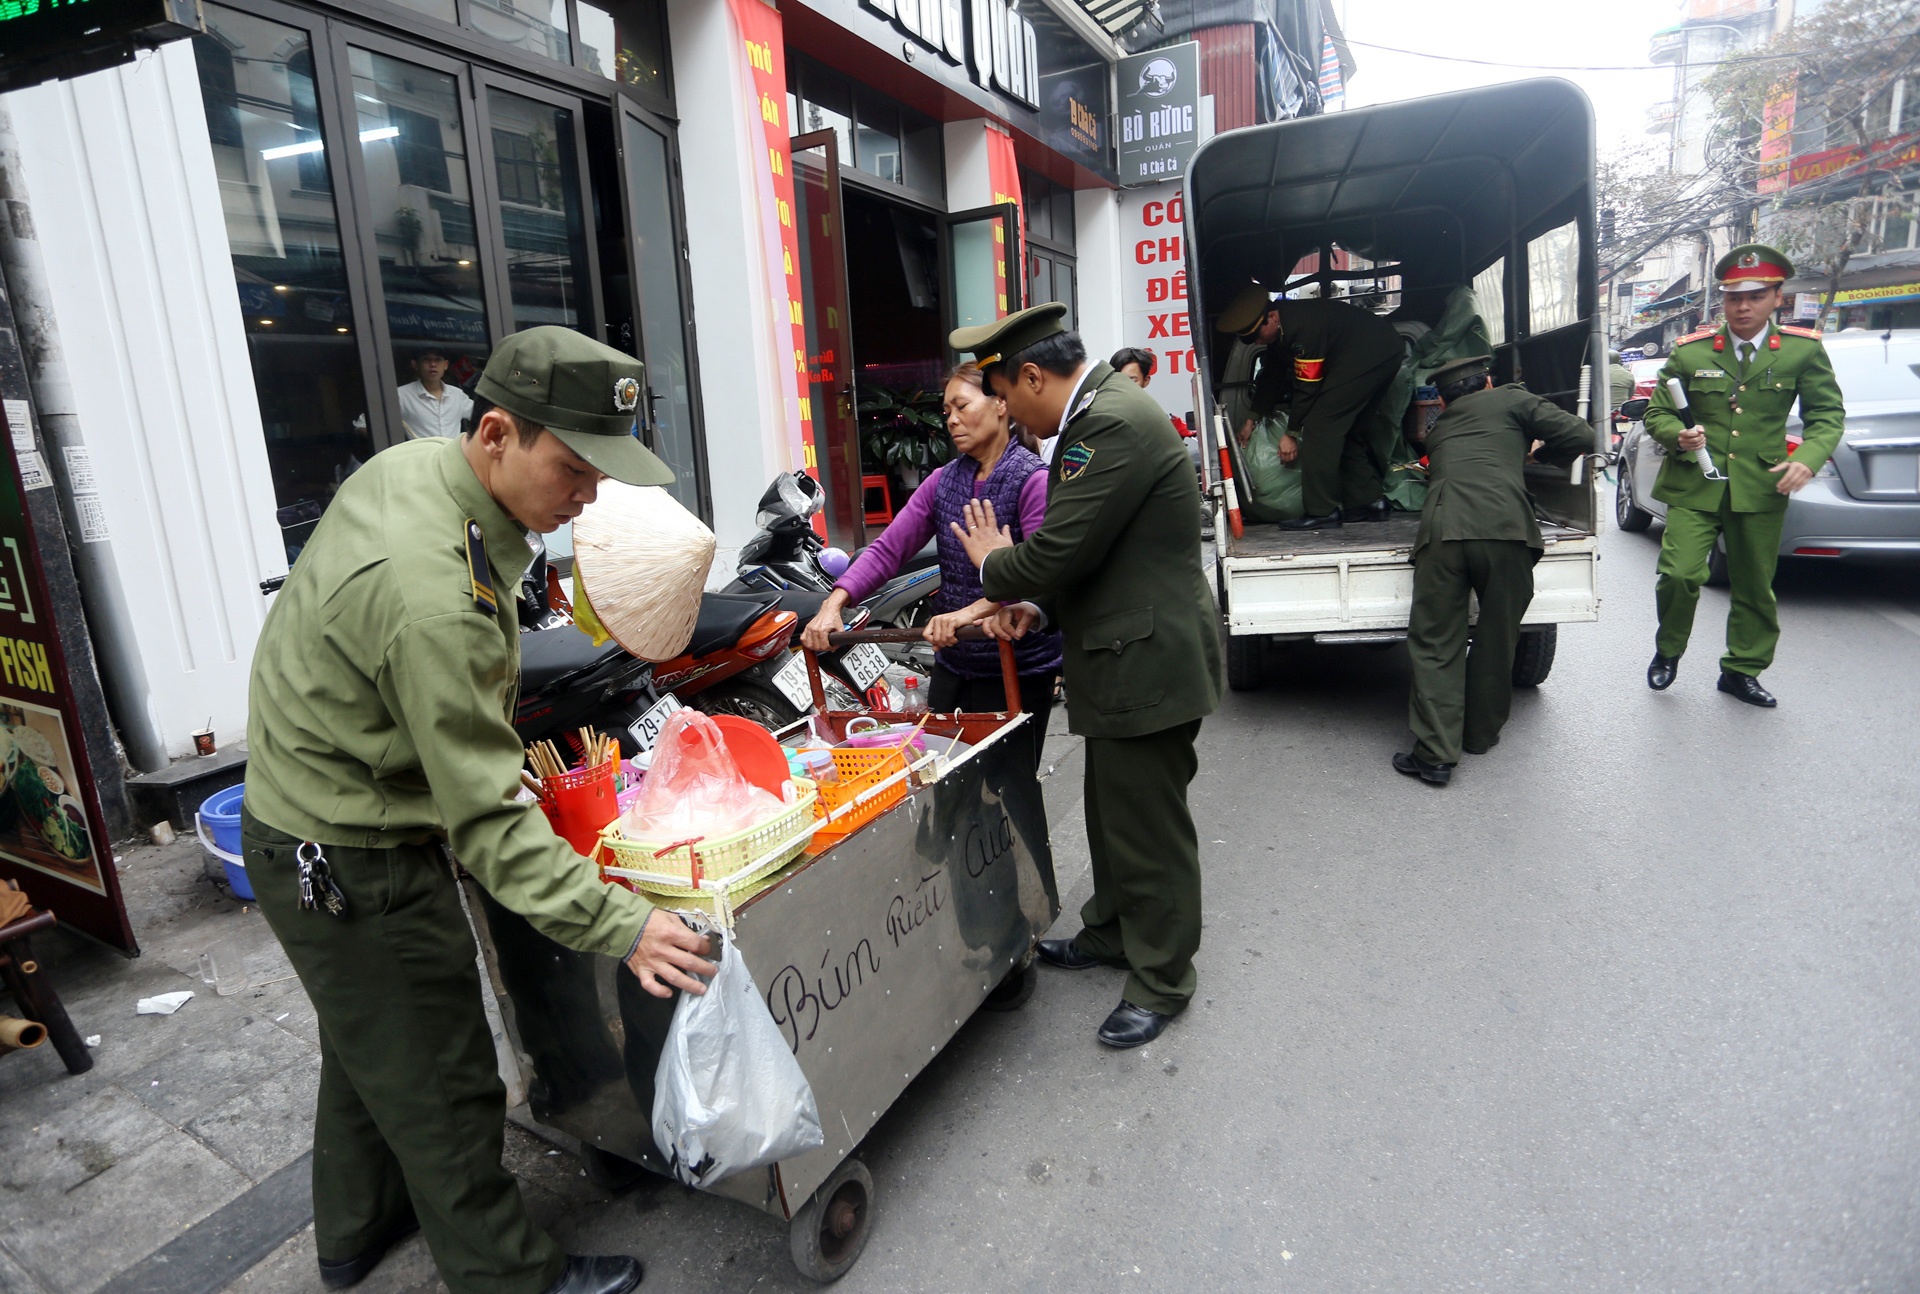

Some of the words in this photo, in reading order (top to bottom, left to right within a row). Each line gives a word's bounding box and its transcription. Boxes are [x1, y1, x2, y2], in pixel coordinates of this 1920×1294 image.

[1122, 109, 1144, 143] BÒ
[1149, 104, 1193, 138] RỪNG
[1144, 142, 1172, 153] QUÁN
[1140, 163, 1148, 176] 19
[1167, 157, 1178, 171] Cá
[1142, 191, 1184, 227] CÓ
[1135, 236, 1187, 265] CH
[1848, 288, 1904, 300] BOOKING
[1147, 312, 1191, 339] XE
[0, 636, 55, 693] FISH
[857, 654, 885, 685] 9638
[766, 938, 880, 1056] Bún
